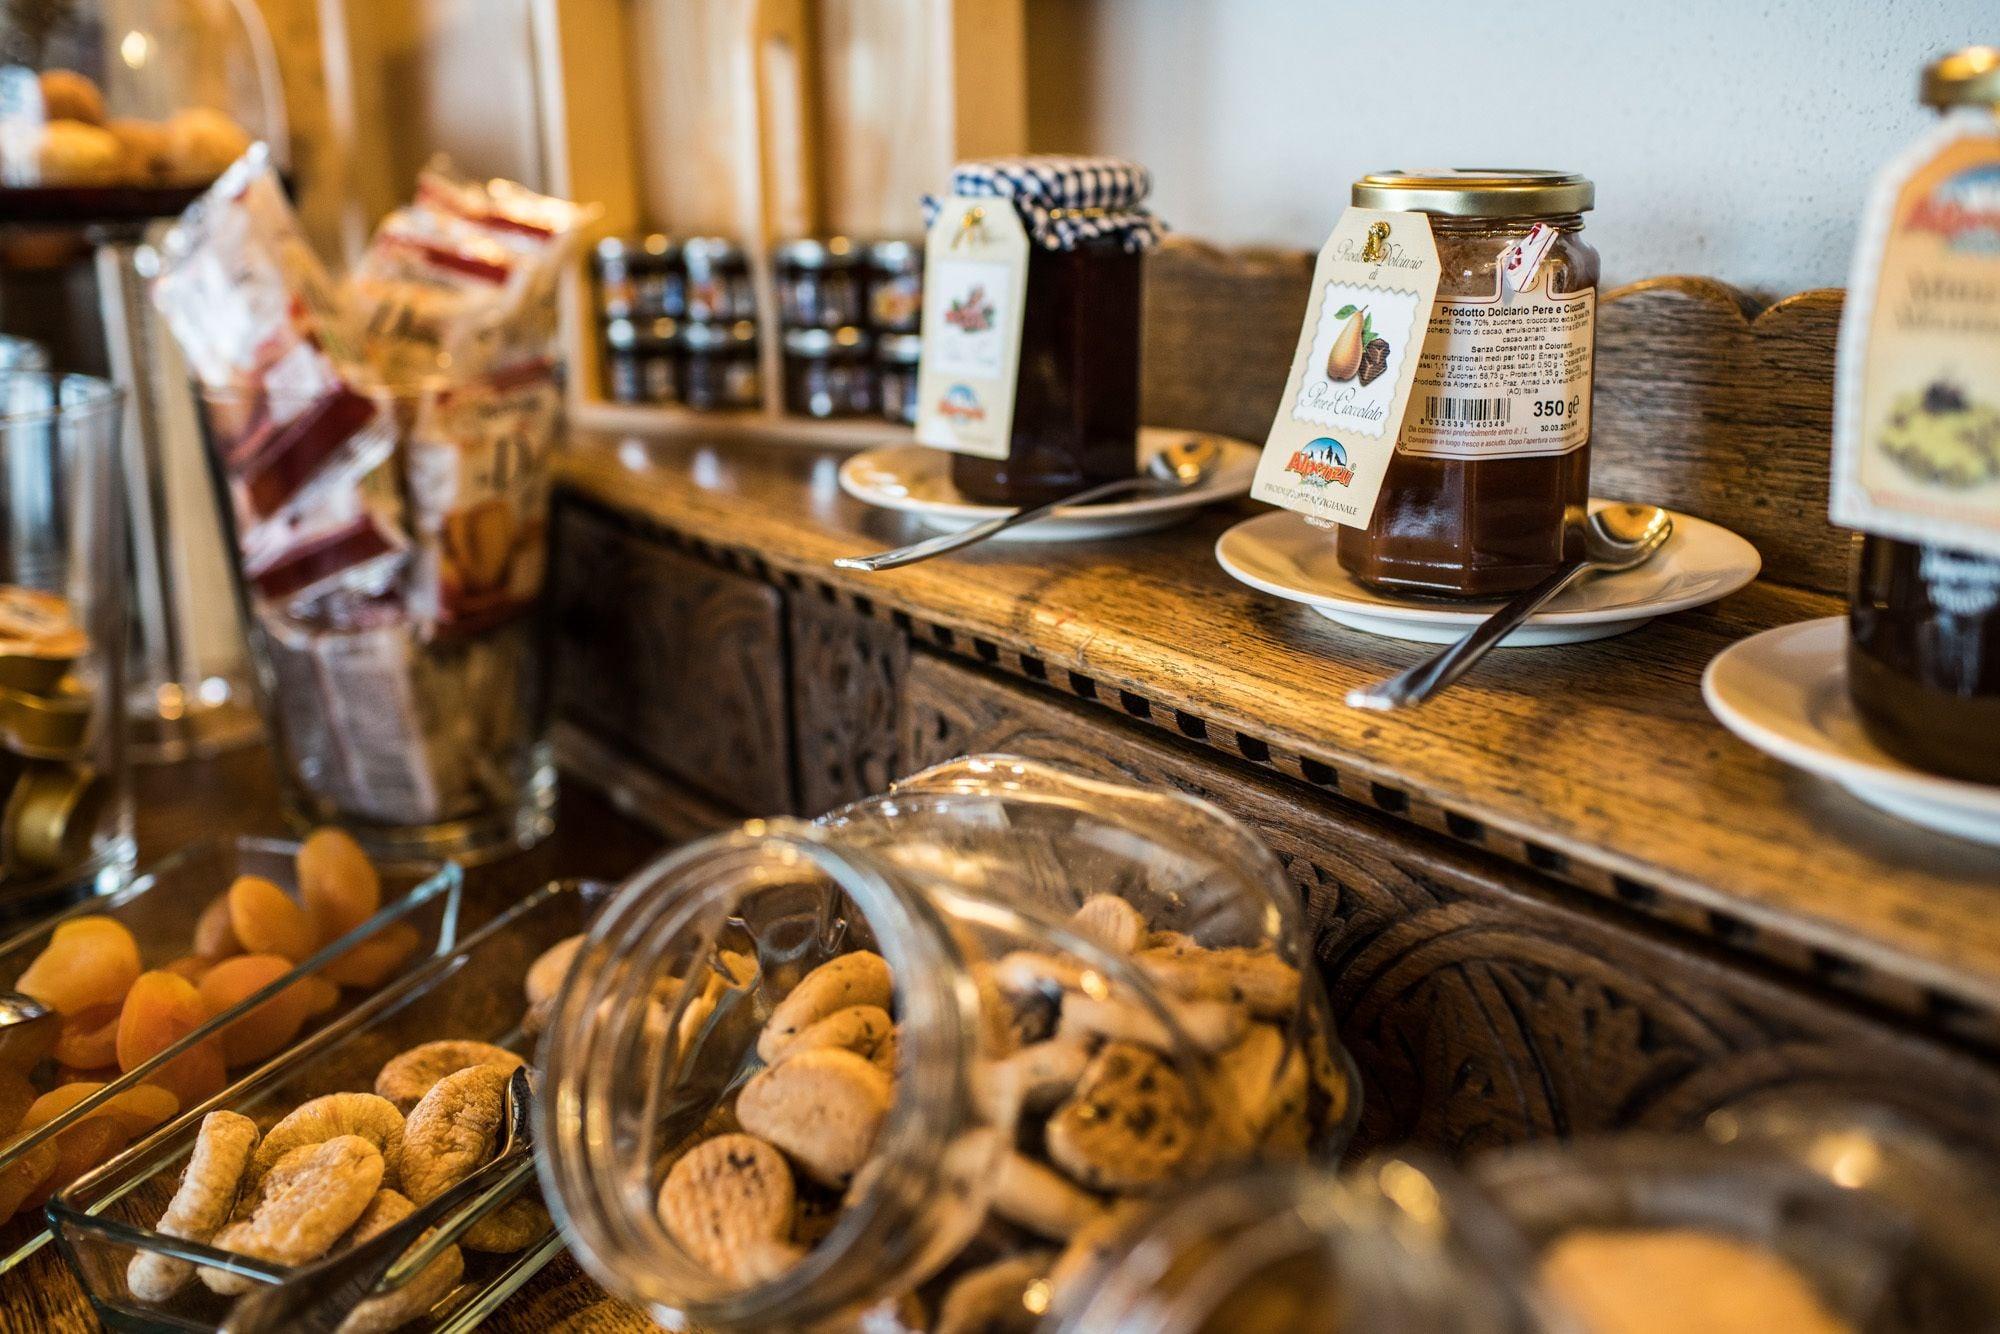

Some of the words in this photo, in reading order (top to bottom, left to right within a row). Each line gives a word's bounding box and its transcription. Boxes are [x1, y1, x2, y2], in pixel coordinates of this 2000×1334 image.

[1441, 306, 1485, 317] Prodotto
[1488, 306, 1530, 317] Dolciario
[1532, 305, 1554, 315] Pere
[1556, 305, 1562, 314] e
[1455, 318, 1471, 326] Pere
[1453, 327, 1471, 335] burro
[1471, 345, 1494, 353] Senza
[1495, 344, 1537, 352] Conservanti
[1442, 354, 1483, 363] nutrizionali
[1503, 354, 1515, 362] per
[1517, 353, 1529, 361] 100
[1413, 377, 1441, 387] Prodotto
[1533, 400, 1564, 417] 350
